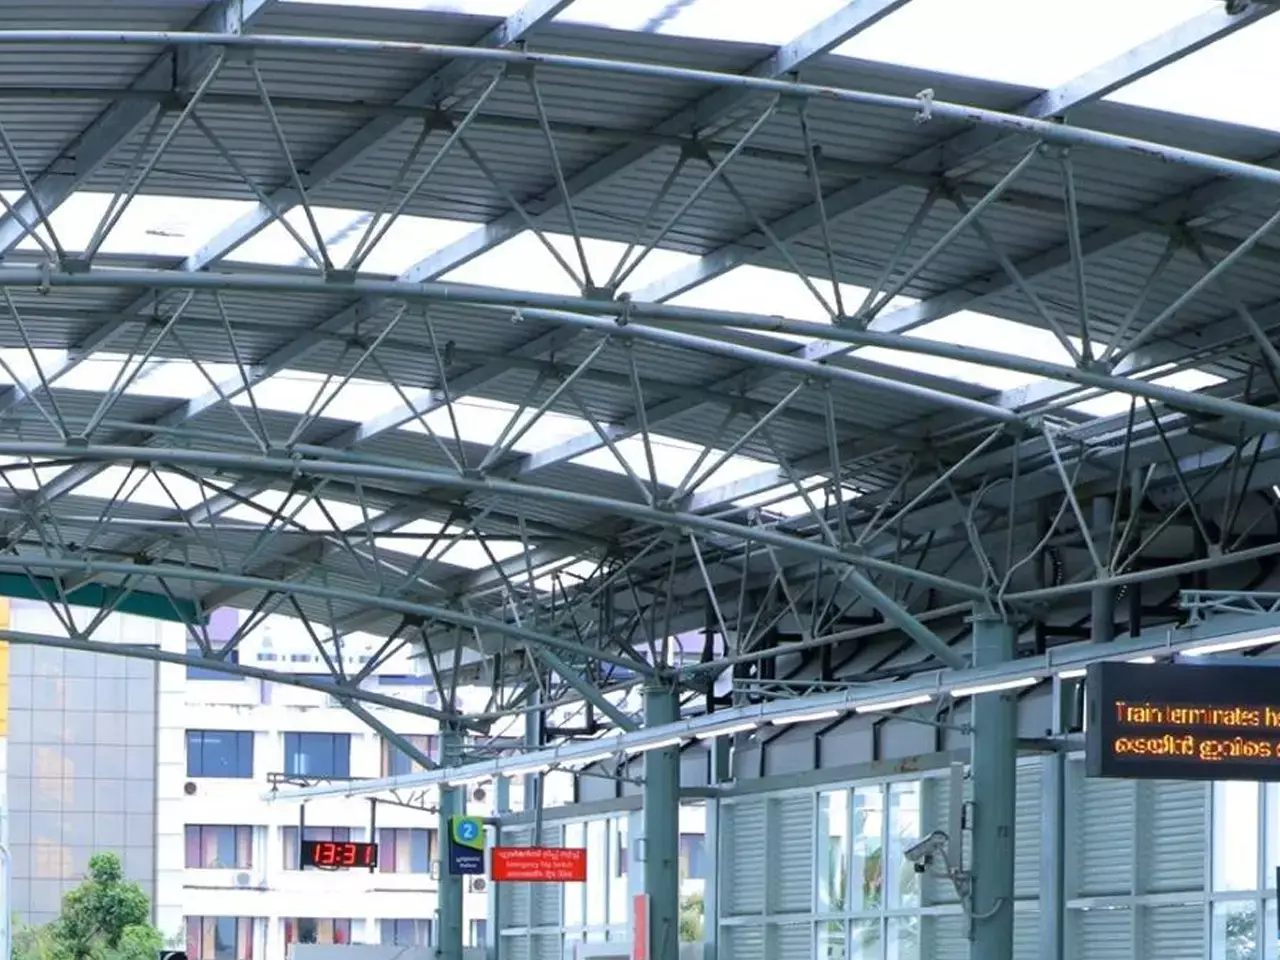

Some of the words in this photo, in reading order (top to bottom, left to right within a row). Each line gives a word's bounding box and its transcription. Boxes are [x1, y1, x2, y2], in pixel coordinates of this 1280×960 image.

[1115, 701, 1162, 724] Train
[1166, 704, 1260, 727] terminates
[463, 823, 473, 838] 2
[314, 843, 372, 866] 13:31
